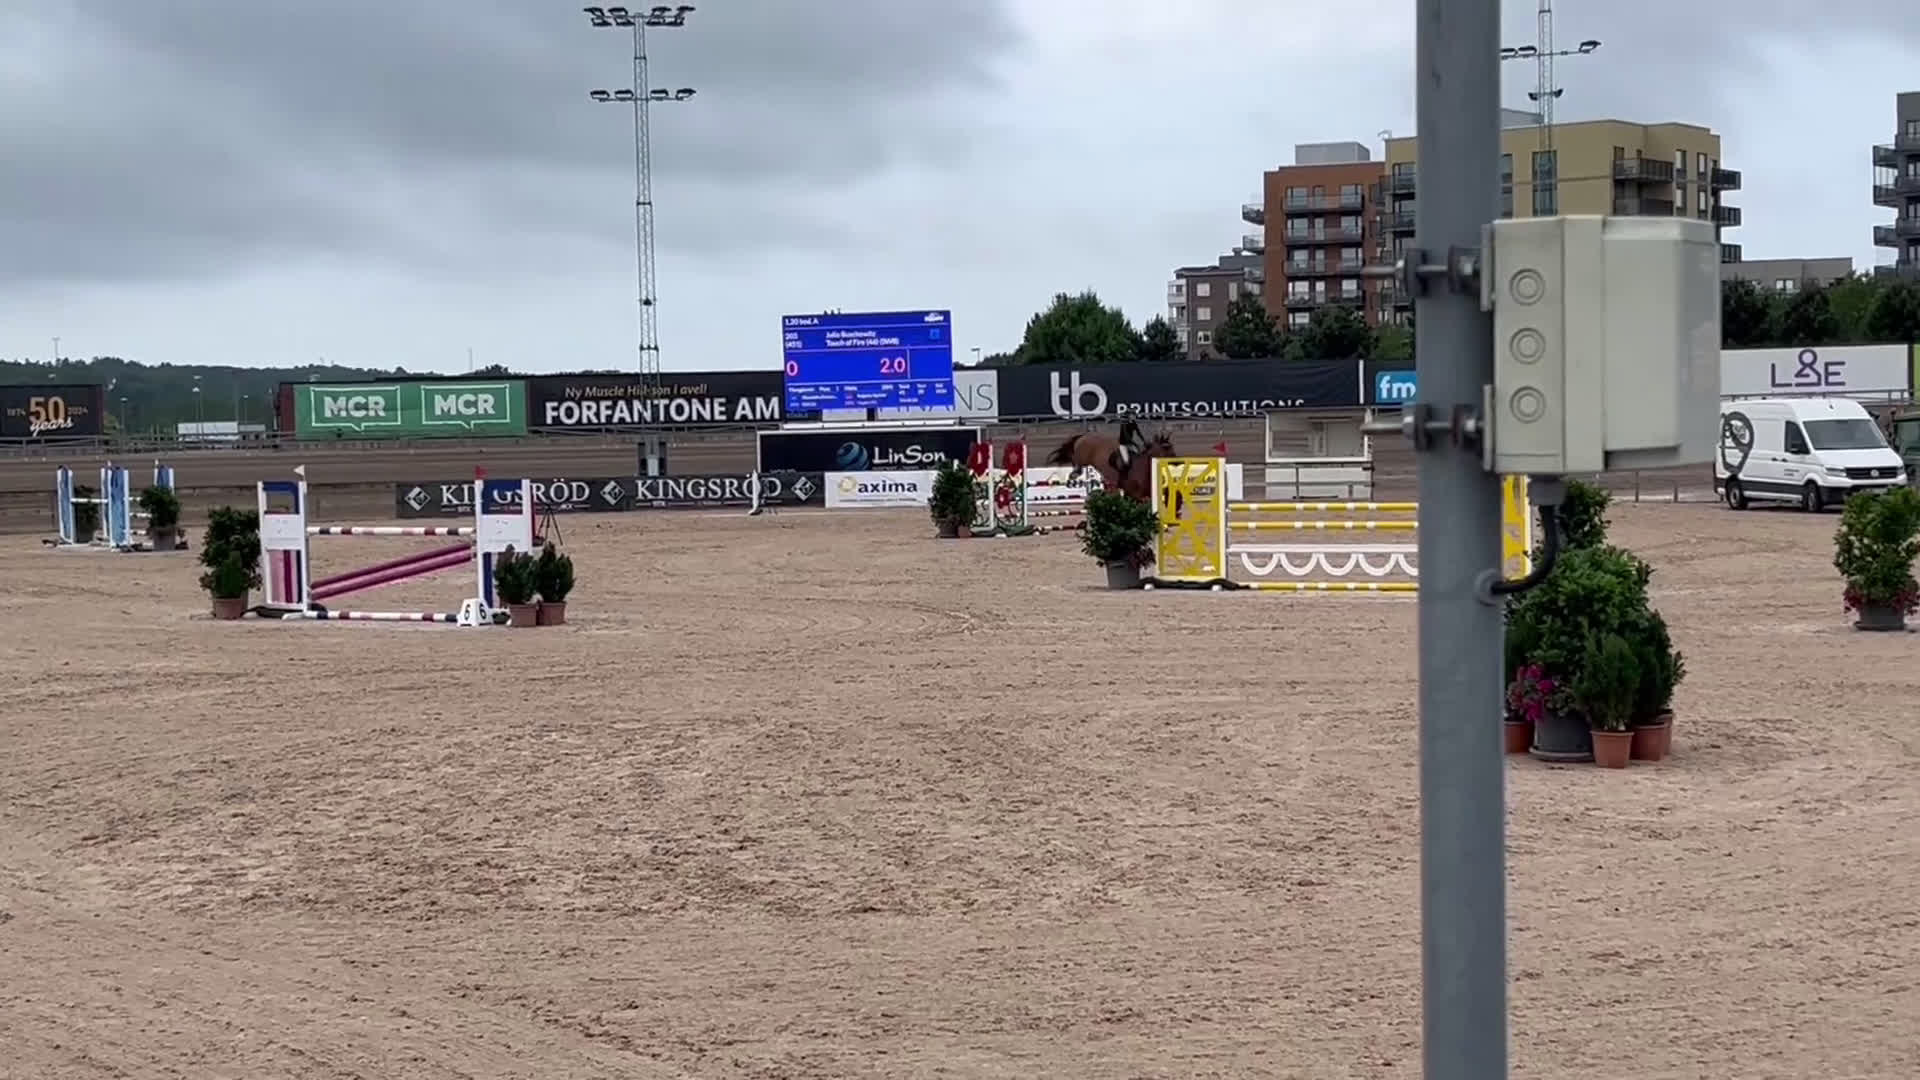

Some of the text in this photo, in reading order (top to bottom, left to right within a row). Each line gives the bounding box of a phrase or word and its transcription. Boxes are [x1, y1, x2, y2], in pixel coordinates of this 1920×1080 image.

[786, 360, 798, 376] 0
[880, 356, 906, 374] 2.0
[434, 393, 496, 416] MCR
[1050, 371, 1107, 418] tb
[29, 396, 65, 422] 50
[324, 395, 386, 418] MCR
[545, 396, 780, 425] FORFANTONE AM
[29, 416, 74, 437] years
[873, 445, 946, 464] LinSon
[858, 479, 918, 494] axima
[464, 603, 471, 621] 6
[479, 603, 487, 620] 6
